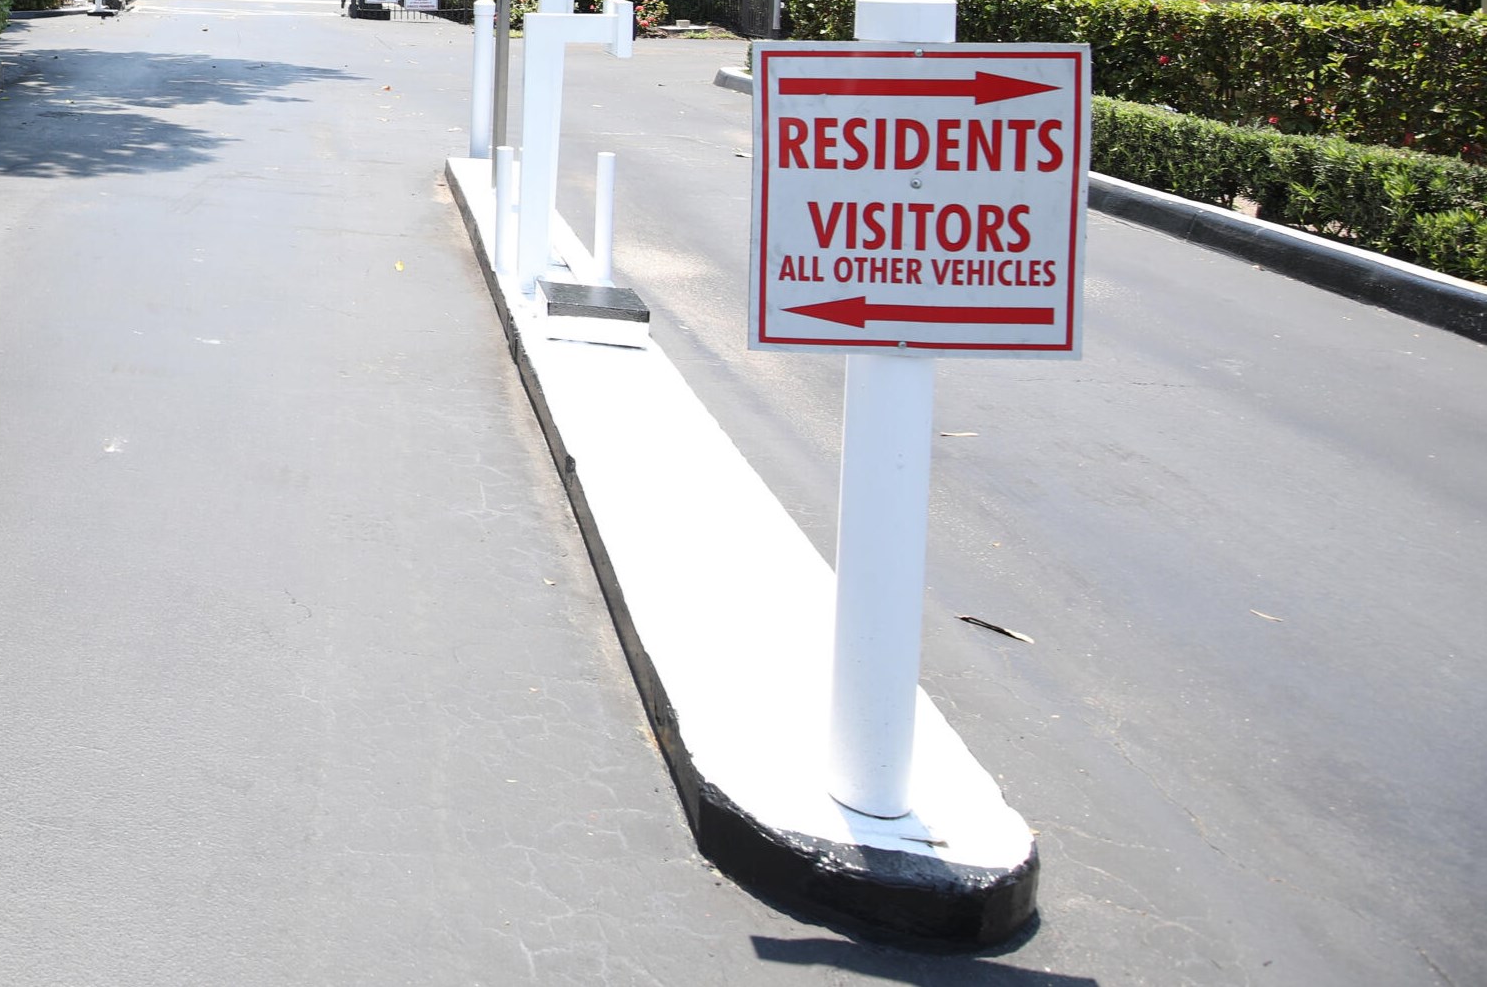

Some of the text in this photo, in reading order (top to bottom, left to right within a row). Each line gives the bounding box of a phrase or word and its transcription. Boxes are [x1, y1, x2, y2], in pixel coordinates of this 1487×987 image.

[778, 117, 1064, 172] RESIDENTS
[807, 201, 1031, 253] VISITORS
[779, 255, 1056, 287] ALL OTHER VEHICLES
